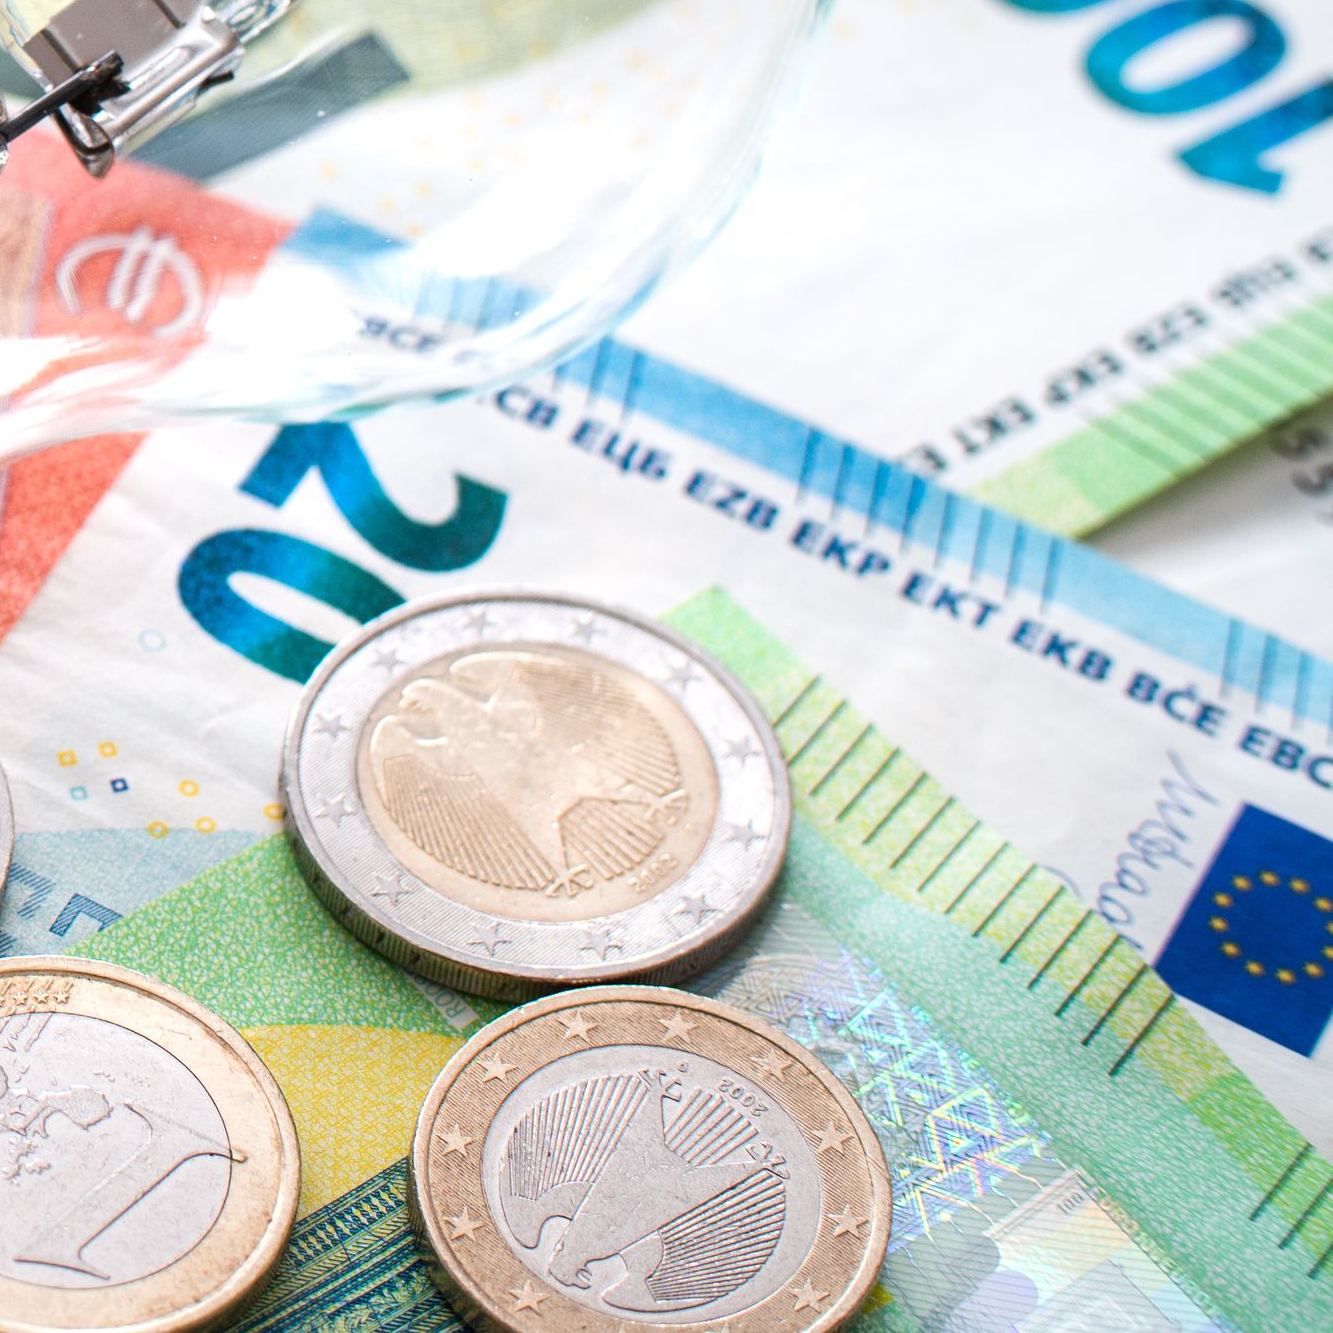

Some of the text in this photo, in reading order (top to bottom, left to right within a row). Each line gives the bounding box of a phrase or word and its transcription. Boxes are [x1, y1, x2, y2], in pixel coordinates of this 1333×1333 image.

[175, 422, 509, 686] 20
[685, 467, 778, 532] EZB
[788, 517, 893, 578] EKP
[899, 566, 1000, 628] EKT
[1010, 618, 1115, 683] EKB
[1236, 728, 1333, 792] EBC
[13, 1102, 248, 1283] 1
[716, 1076, 770, 1117] 2002
